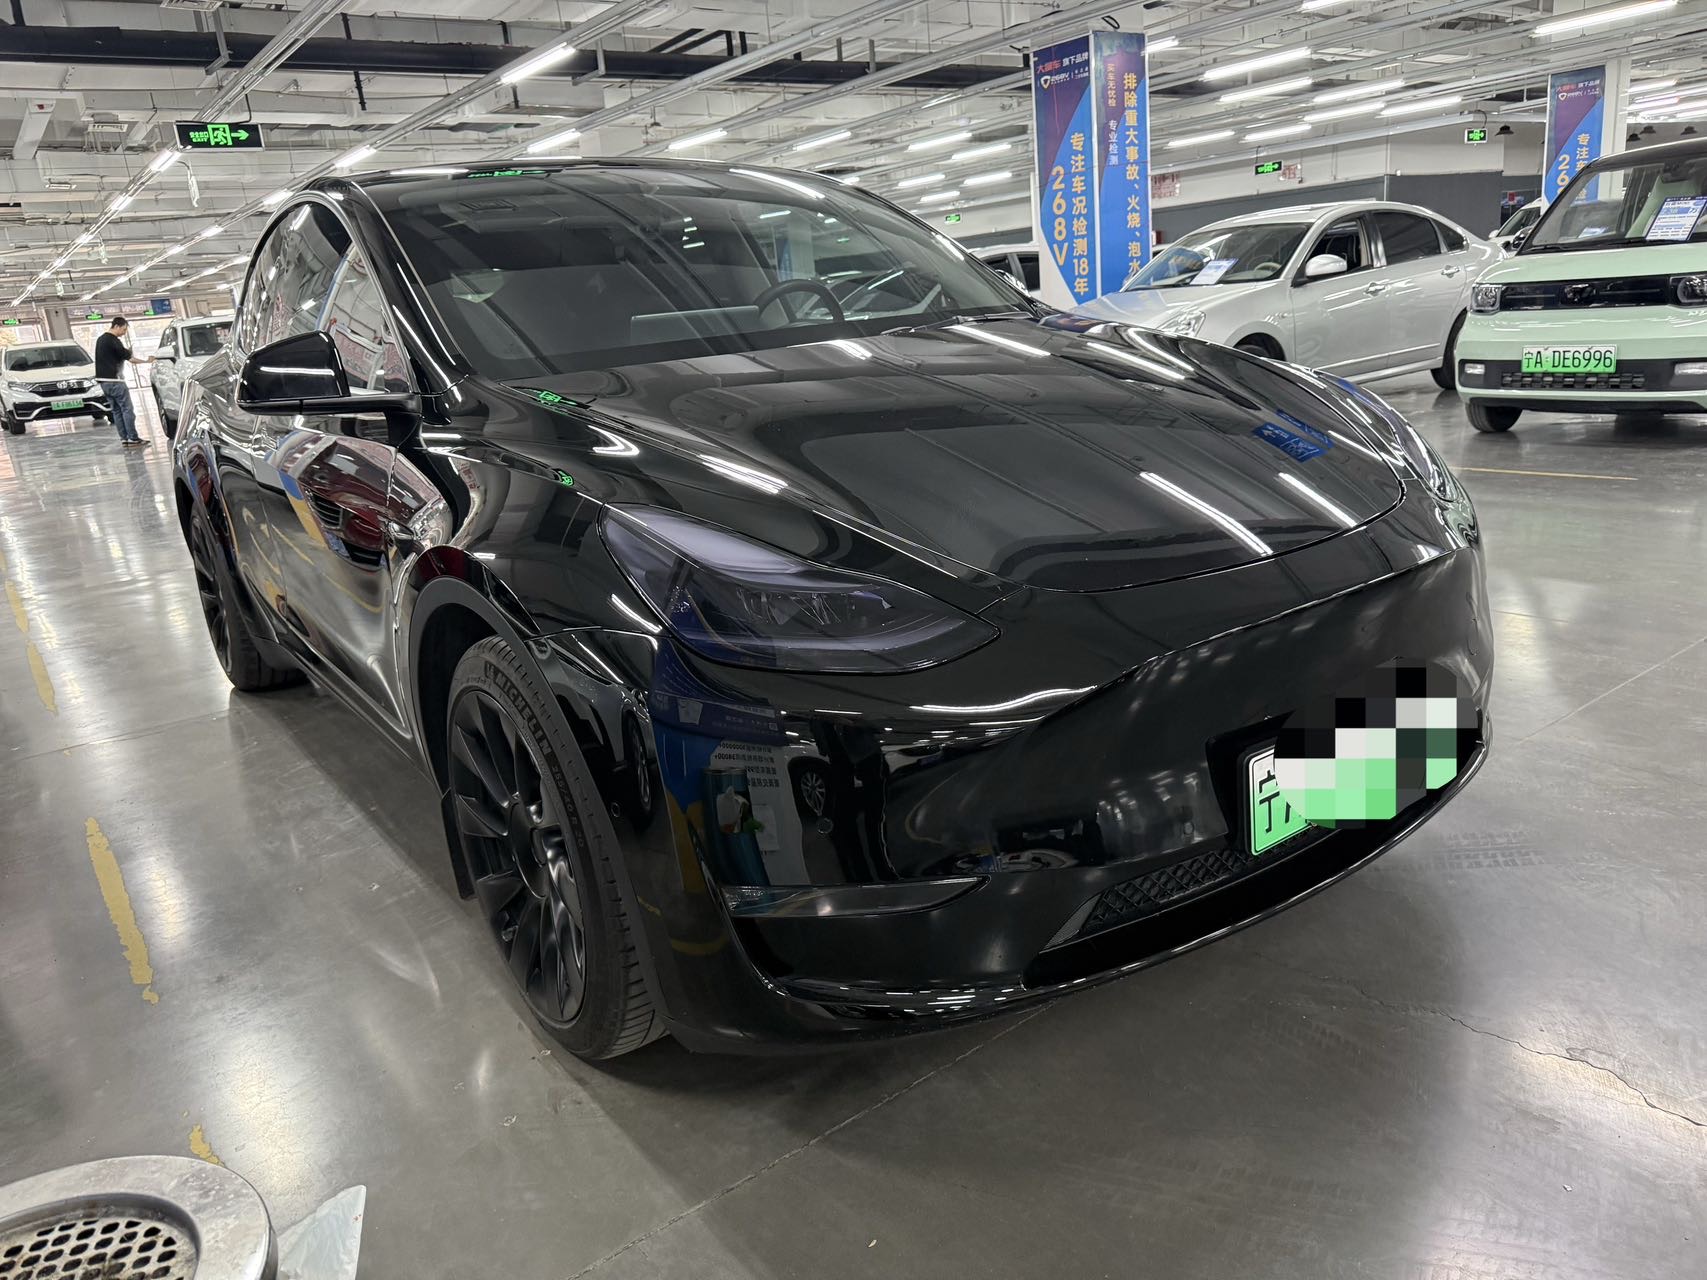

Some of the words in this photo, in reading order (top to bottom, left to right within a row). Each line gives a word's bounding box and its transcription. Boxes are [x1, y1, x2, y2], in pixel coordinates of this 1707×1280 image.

[1108, 120, 1119, 166] 专业检测
[1051, 166, 1069, 267] 268V
[1524, 350, 1543, 369] 宁A
[1552, 349, 1613, 369] DE6996
[494, 673, 553, 756] MICHELIN
